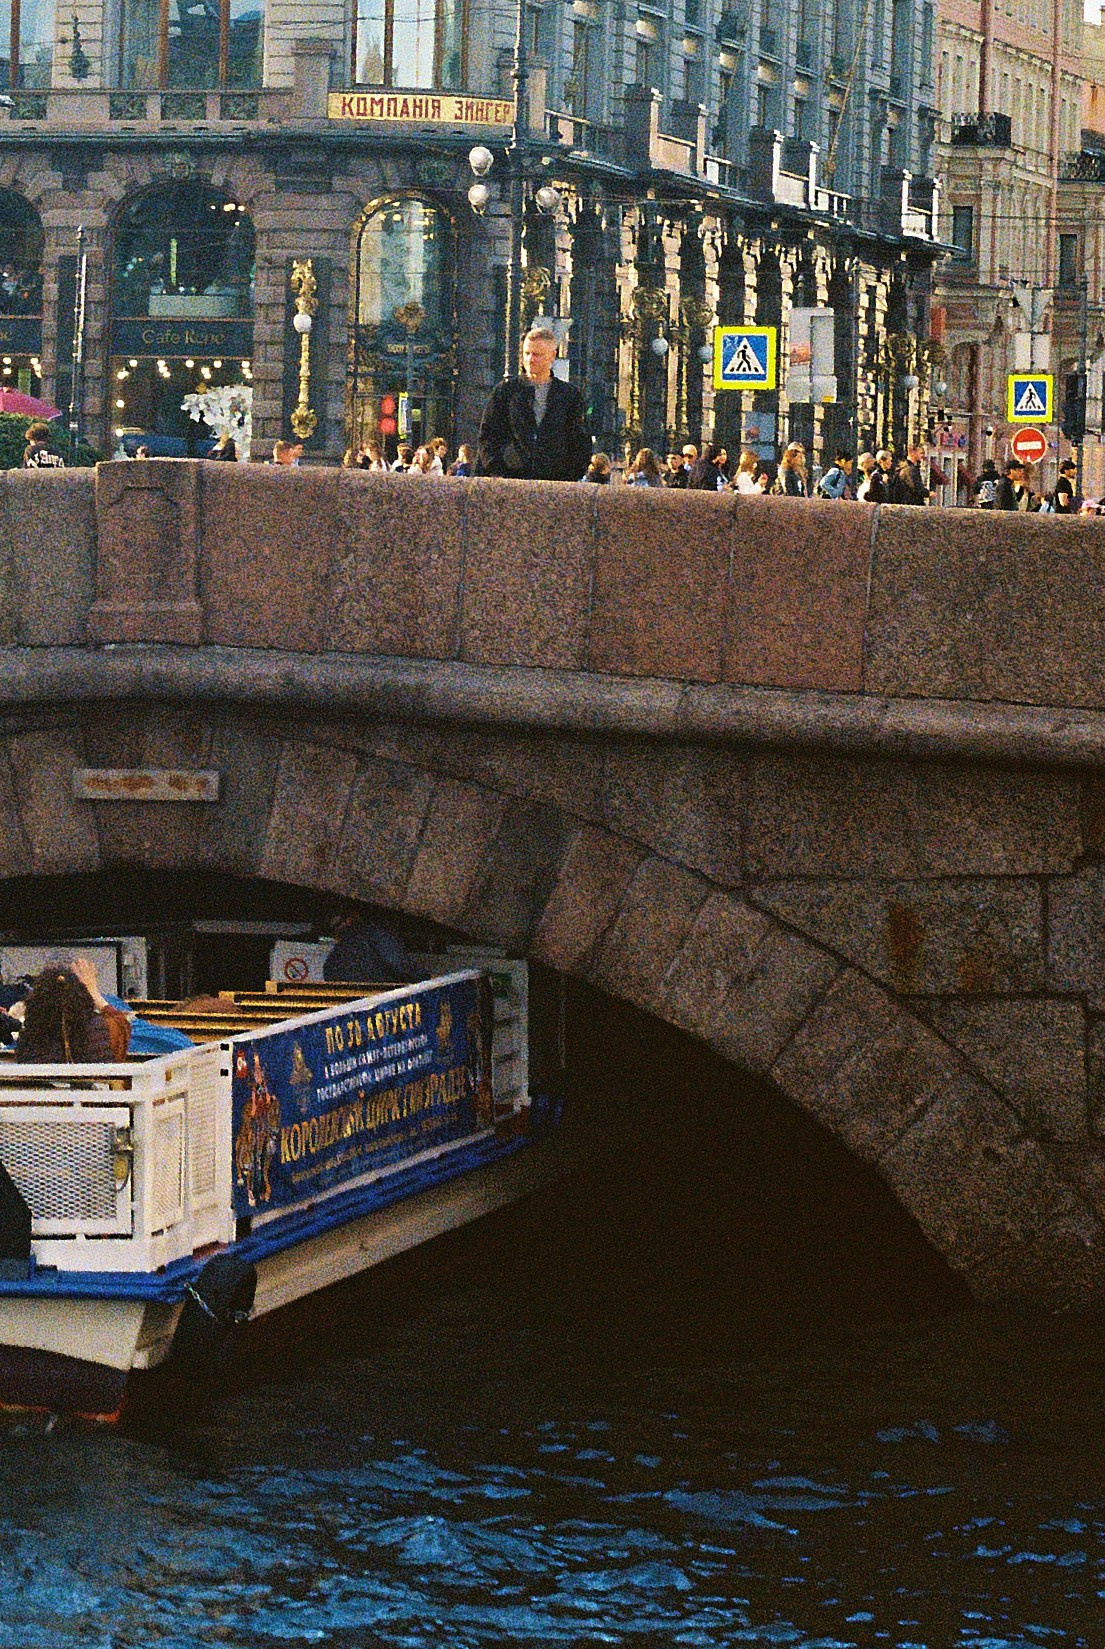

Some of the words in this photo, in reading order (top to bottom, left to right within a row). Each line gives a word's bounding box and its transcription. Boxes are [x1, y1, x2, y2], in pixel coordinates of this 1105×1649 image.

[341, 96, 441, 119] КОМПАНІЯ
[325, 1025, 344, 1054] ПО
[366, 1002, 421, 1040] АВГУСТА
